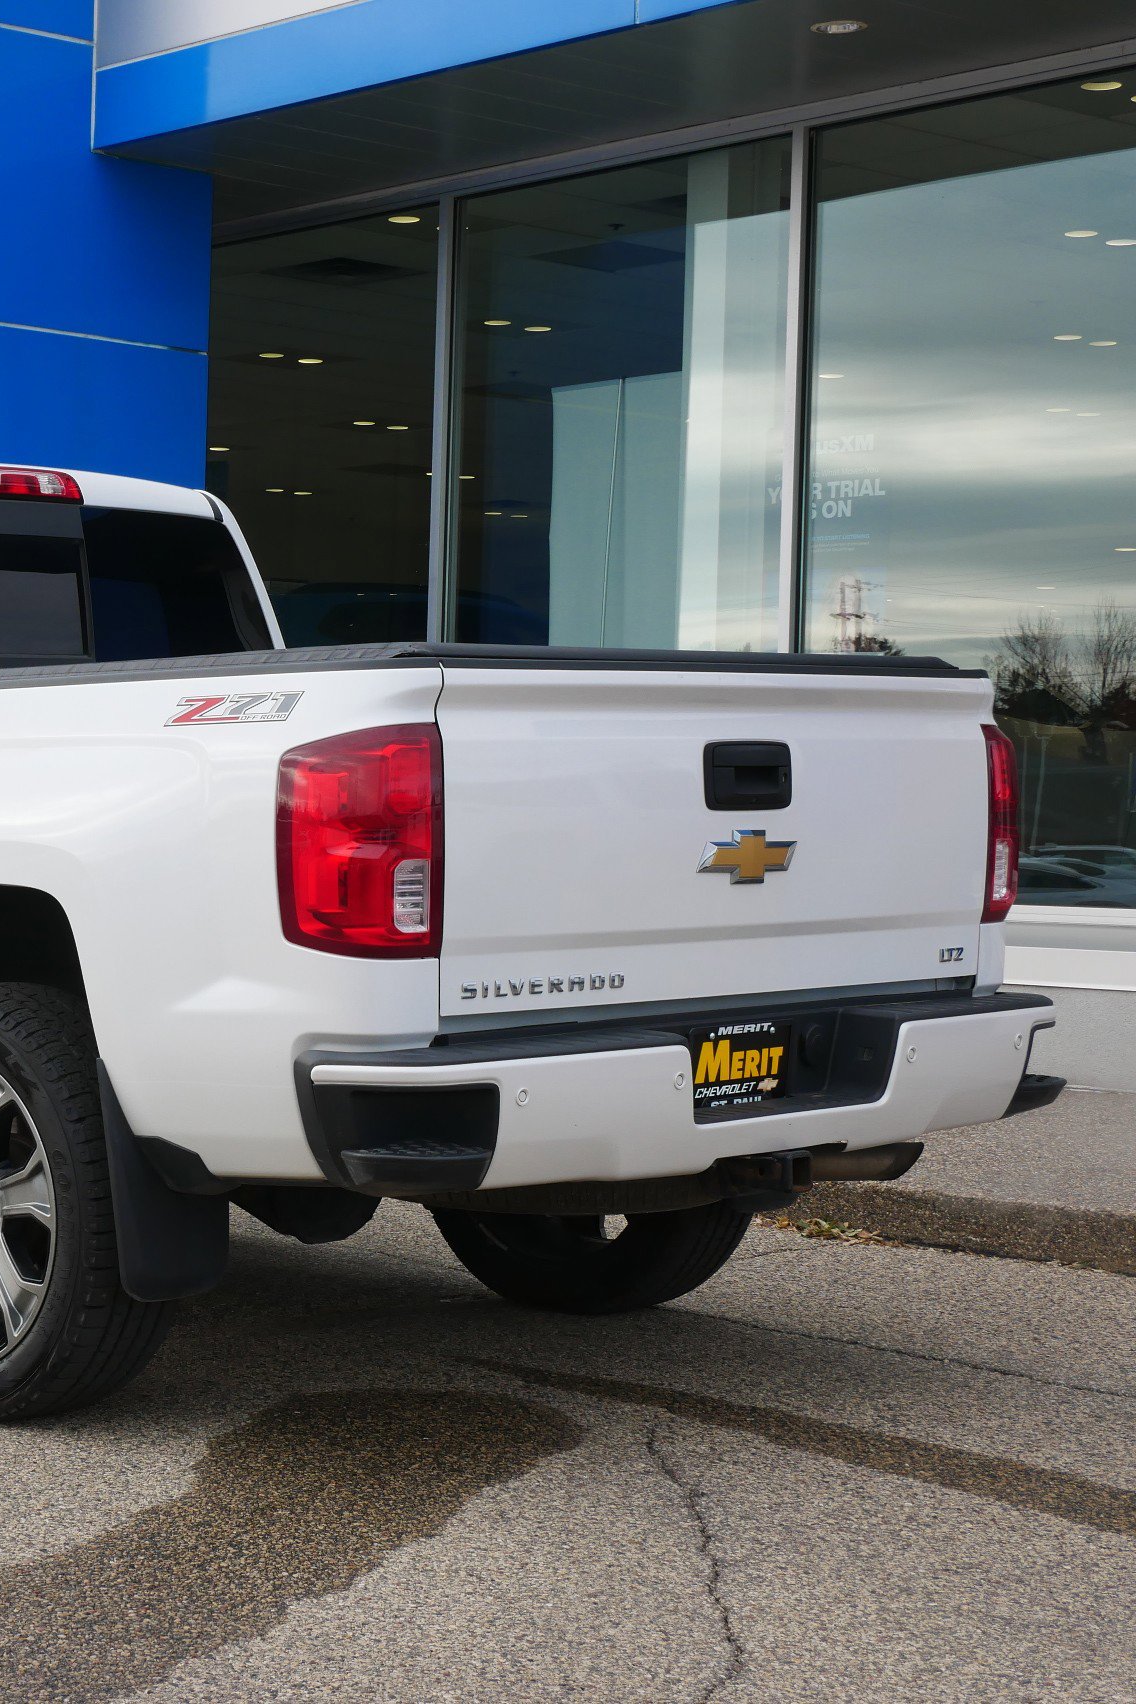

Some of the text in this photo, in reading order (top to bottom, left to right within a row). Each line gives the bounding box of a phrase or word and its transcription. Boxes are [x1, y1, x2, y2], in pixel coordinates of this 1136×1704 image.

[827, 478, 886, 499] TRIAL
[821, 500, 852, 519] ON
[163, 691, 305, 727] Z71
[939, 947, 964, 963] LTZ
[461, 971, 625, 1000] SILVERADO
[717, 1022, 772, 1036] MERIT
[694, 1081, 757, 1099] CHEVROLET
